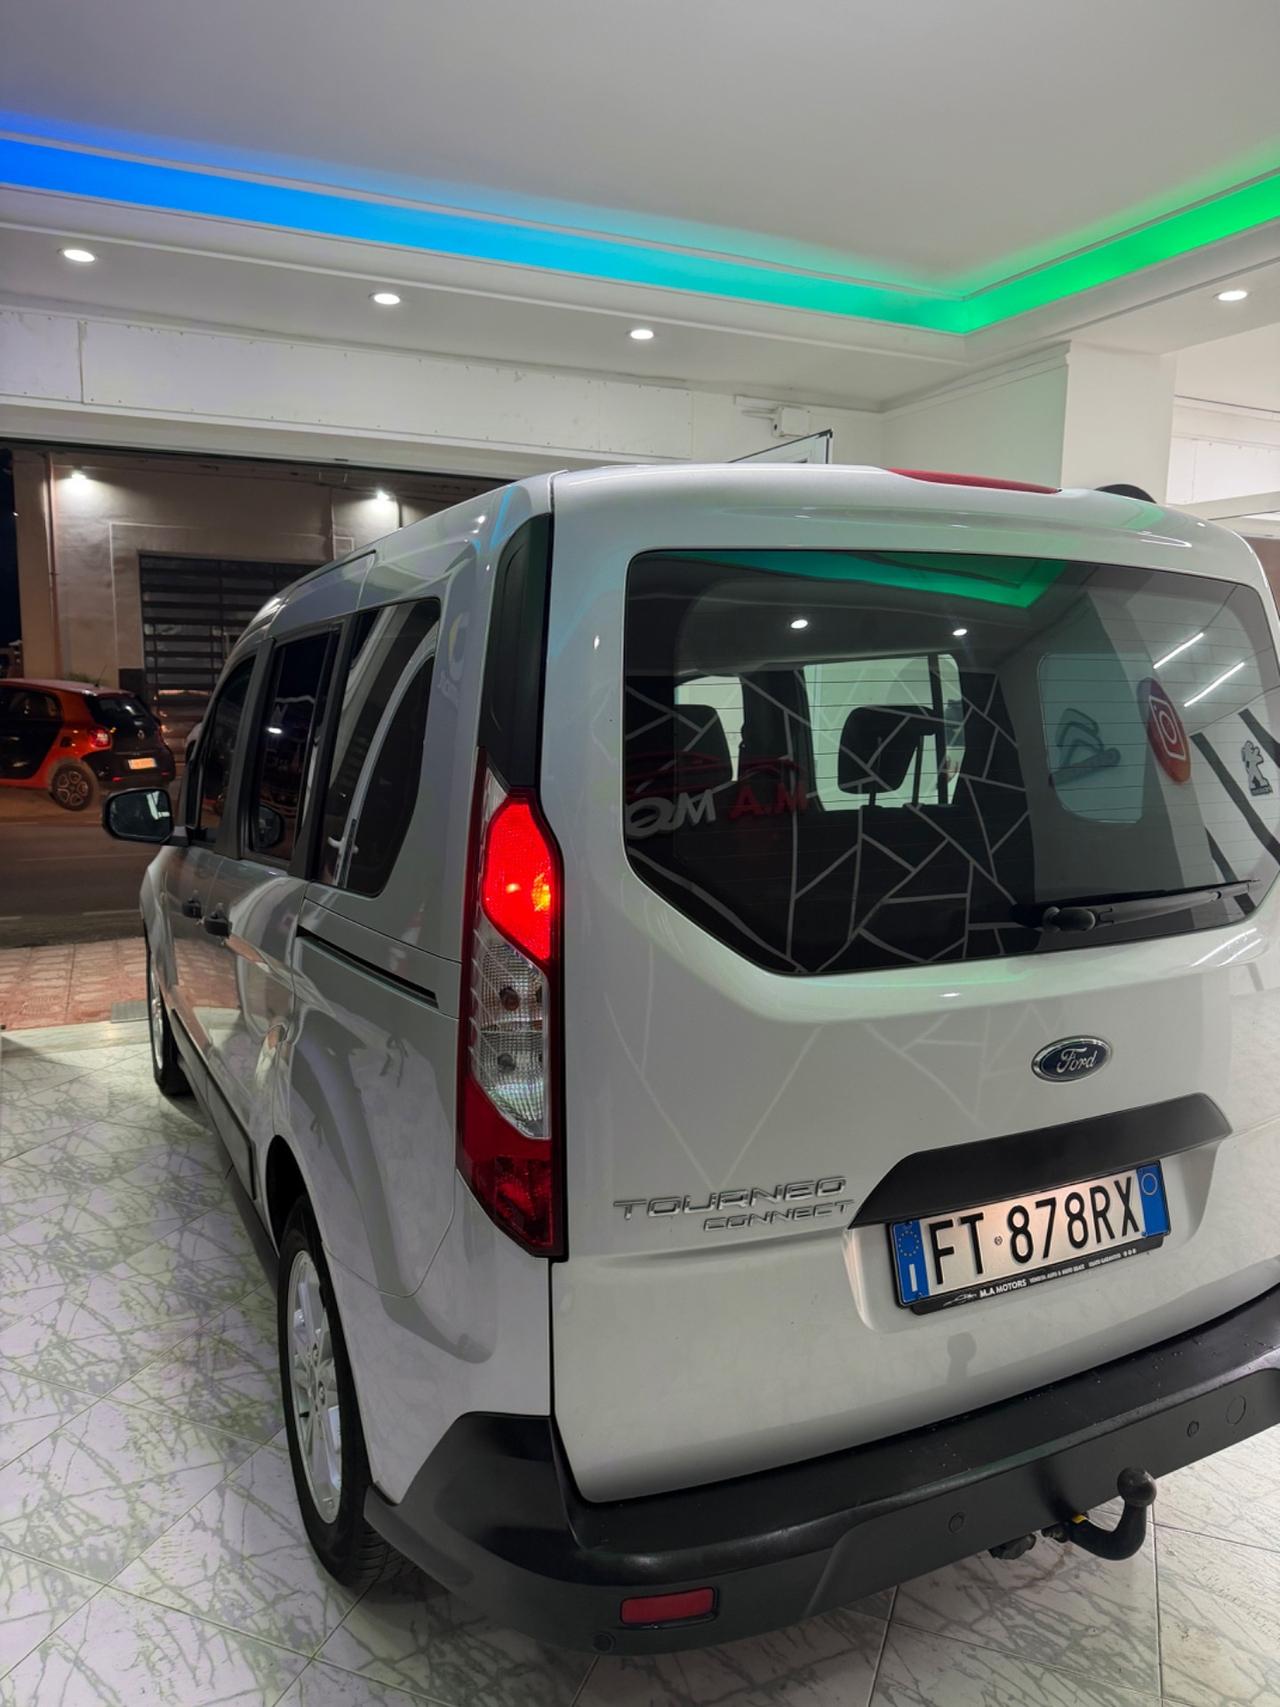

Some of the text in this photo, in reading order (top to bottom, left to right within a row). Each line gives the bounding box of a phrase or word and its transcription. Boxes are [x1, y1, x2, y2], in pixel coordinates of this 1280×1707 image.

[1056, 1047, 1098, 1073] Ford
[613, 1175, 847, 1221] TOURNEO
[703, 1200, 855, 1231] CONNECT
[928, 1176, 1140, 1285] FT 878RX
[996, 1279, 1028, 1293] MOTORS
